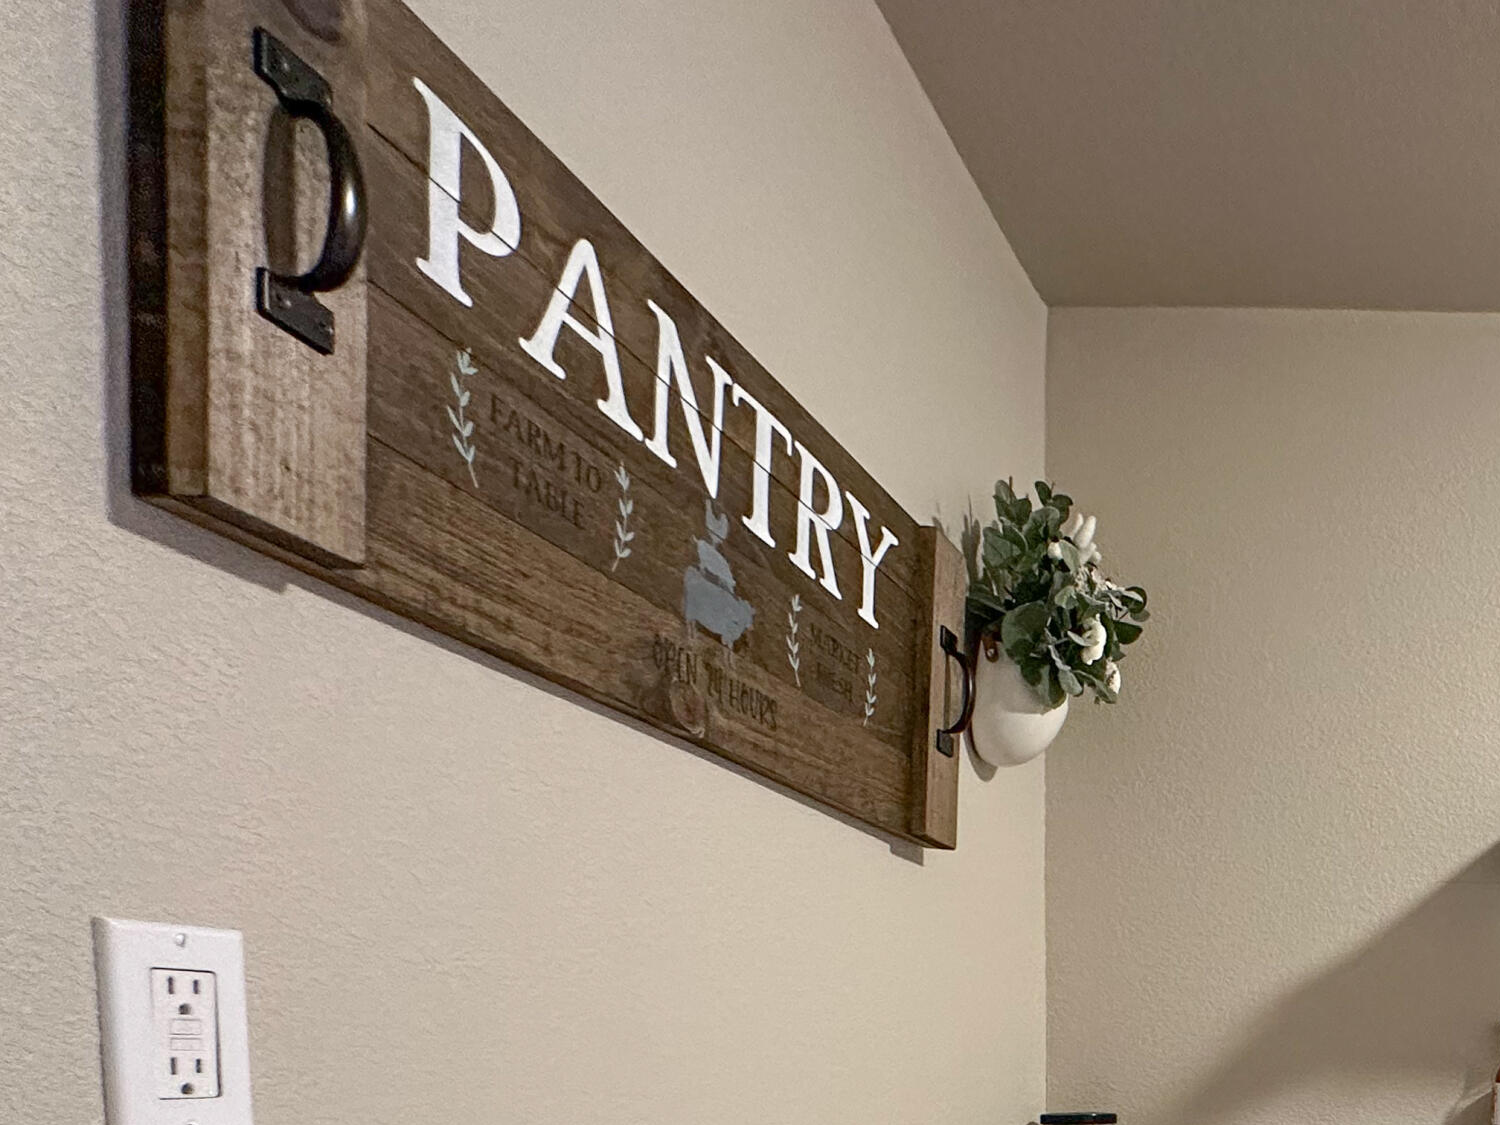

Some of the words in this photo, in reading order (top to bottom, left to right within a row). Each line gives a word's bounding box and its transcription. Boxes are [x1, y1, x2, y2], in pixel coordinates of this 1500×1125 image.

[412, 76, 899, 629] PANTRY
[489, 393, 567, 472] FARM
[571, 451, 602, 494] TO
[510, 456, 587, 530] TABLE
